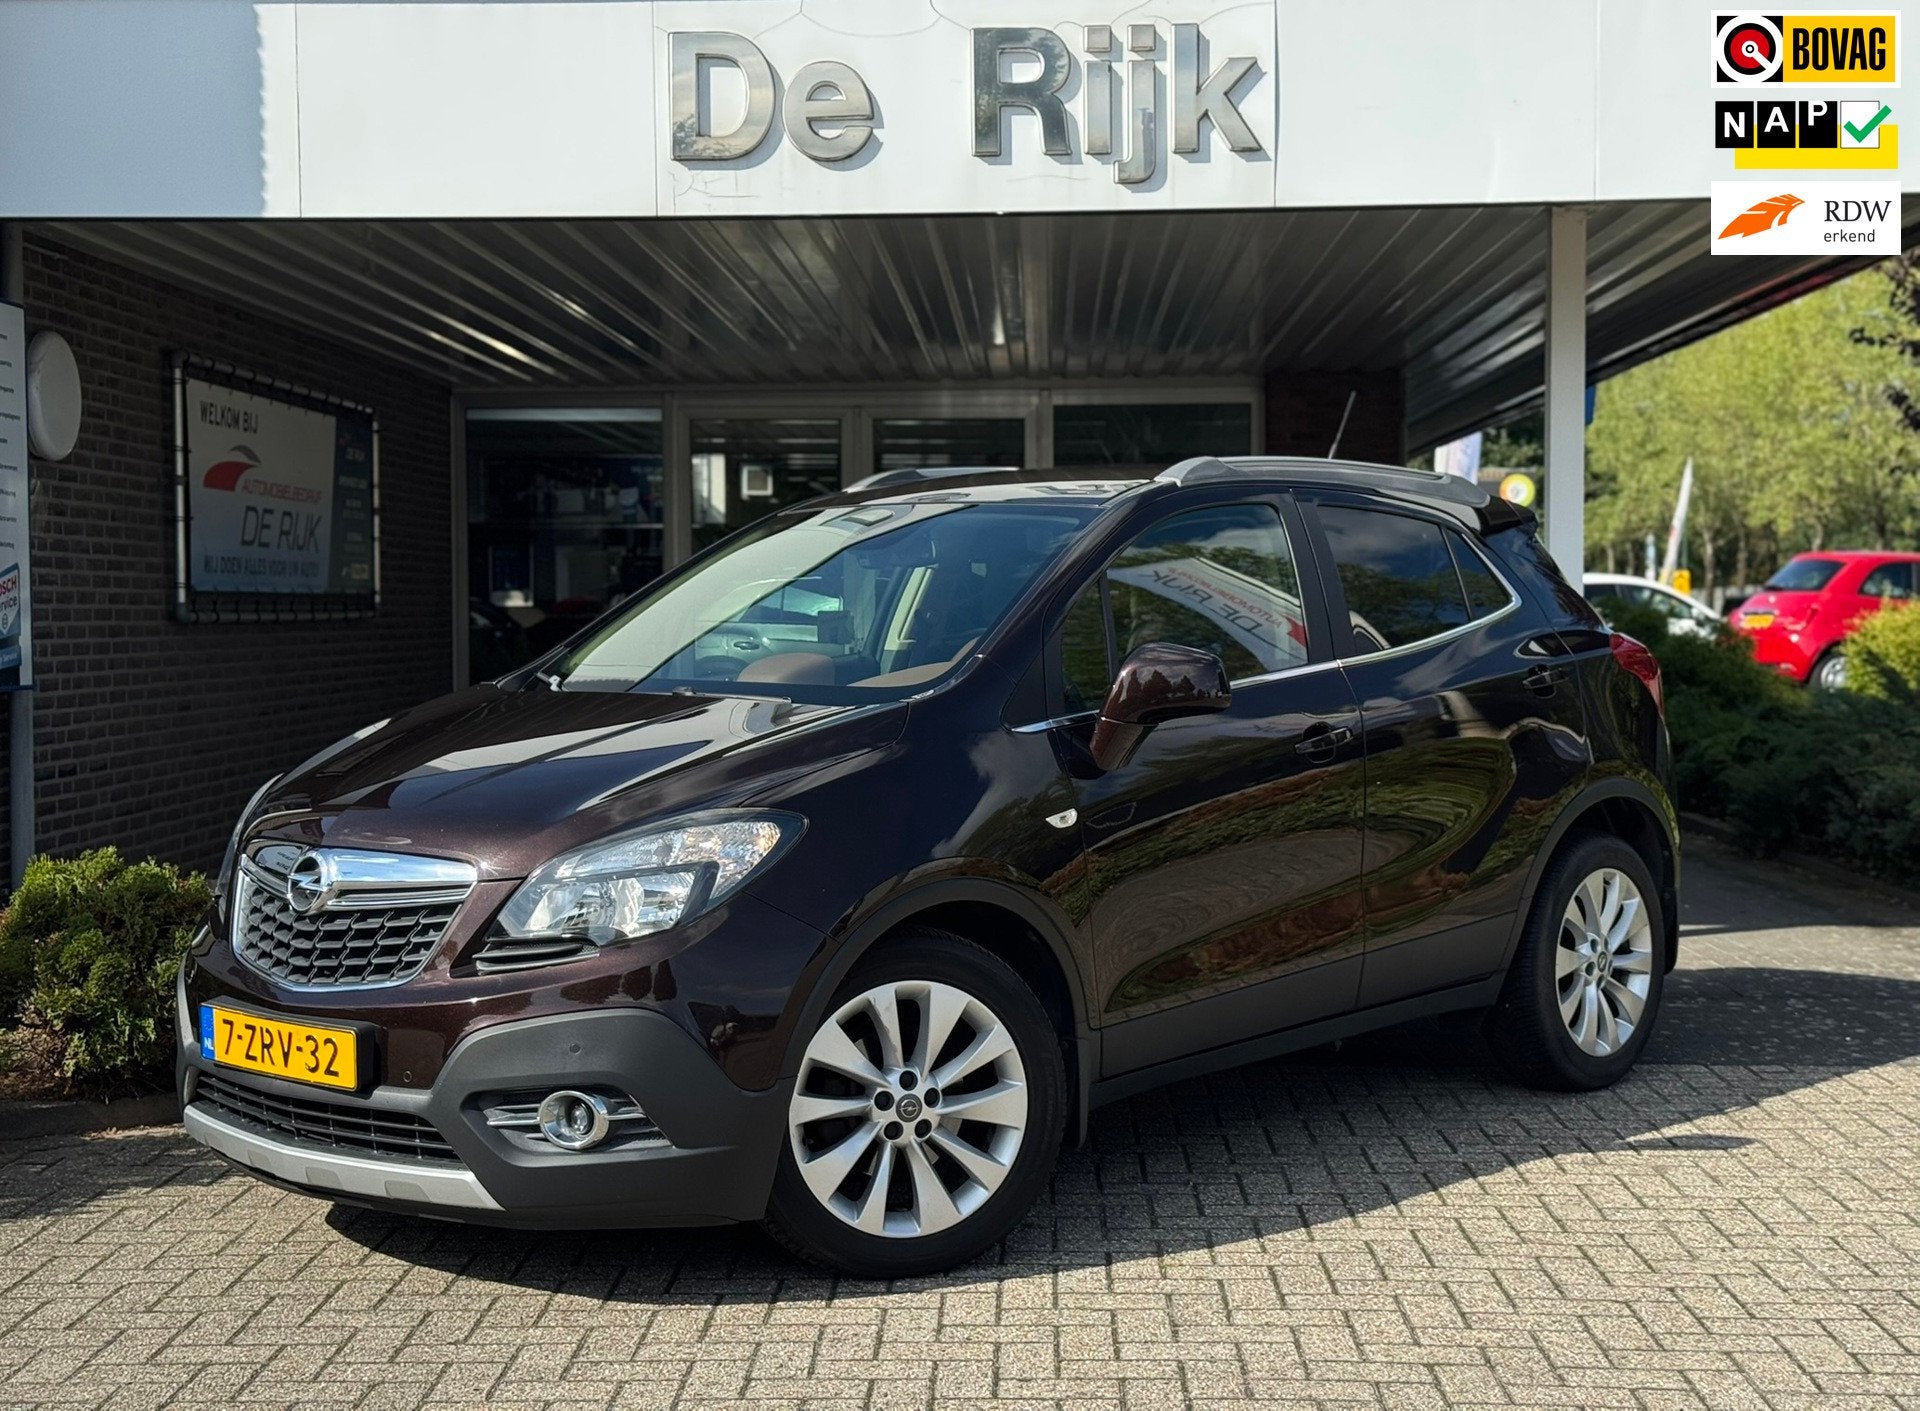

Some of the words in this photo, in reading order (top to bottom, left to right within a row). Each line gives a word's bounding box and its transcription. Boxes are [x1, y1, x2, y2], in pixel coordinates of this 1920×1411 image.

[668, 31, 875, 162] De
[970, 23, 1262, 184] Rijk
[200, 400, 240, 430] WELKOM
[243, 410, 259, 434] BIJ
[241, 505, 274, 548] DE
[277, 511, 322, 553] RIJK
[204, 1036, 214, 1050] NL
[222, 1018, 340, 1077] 7-ZRV-32
